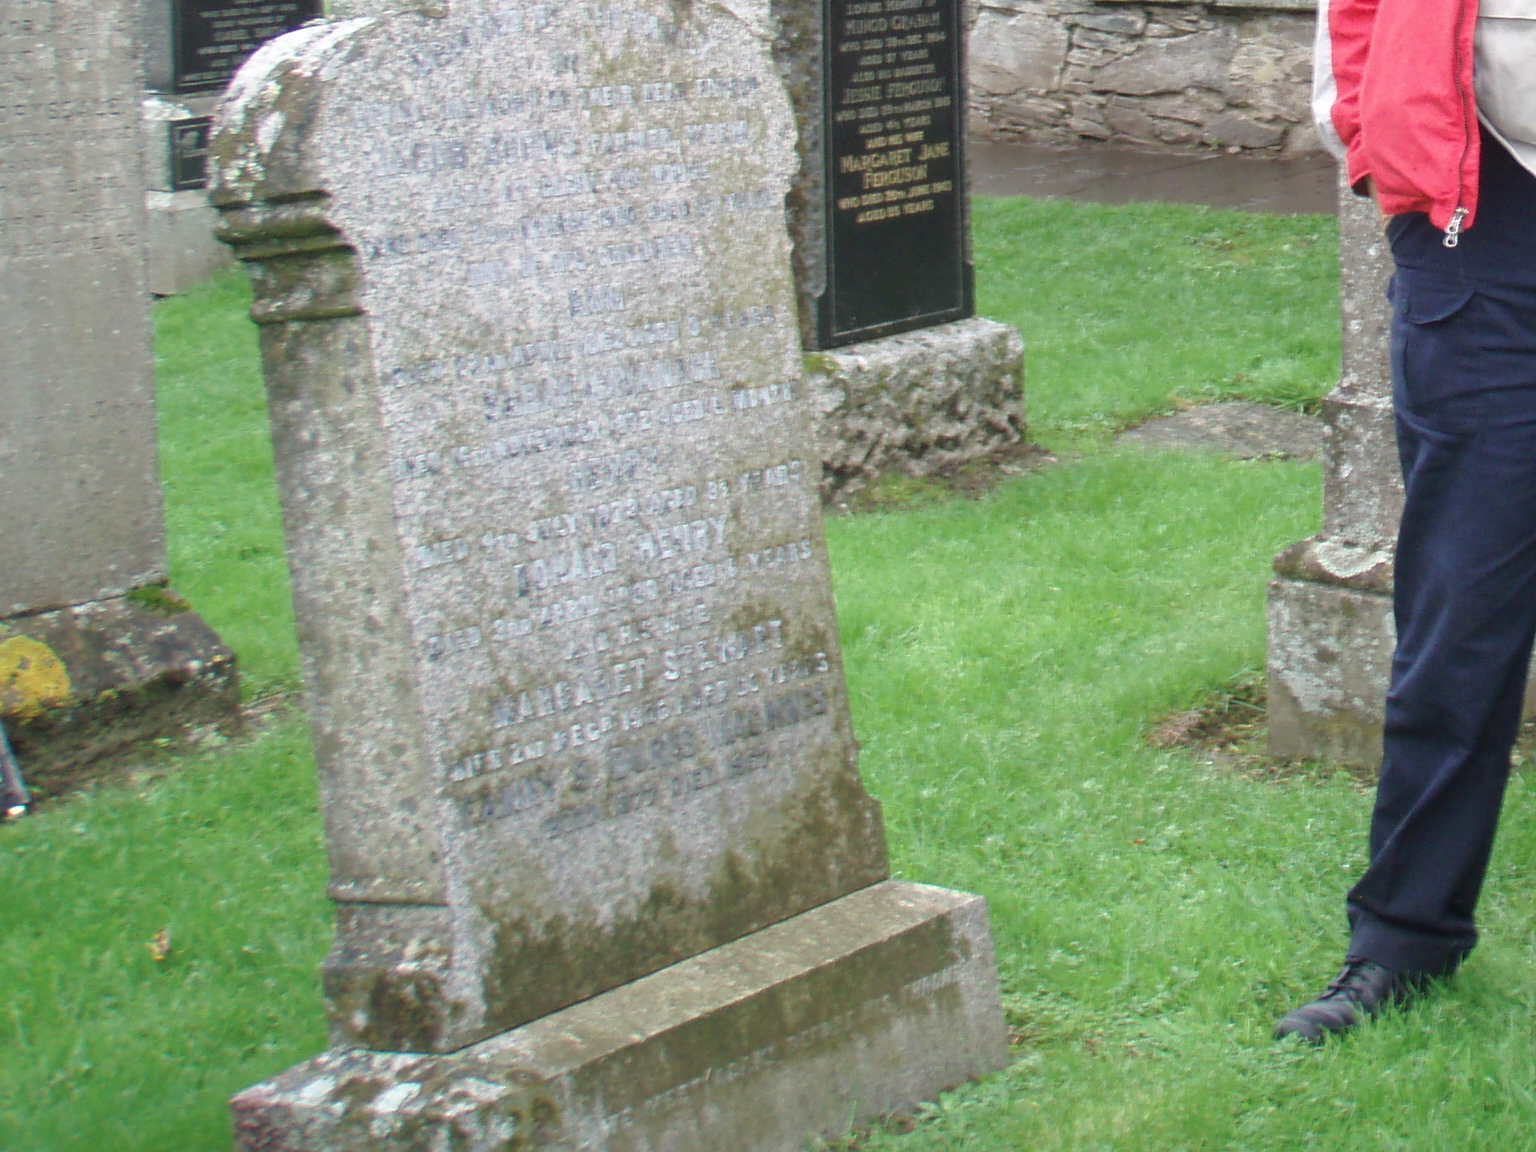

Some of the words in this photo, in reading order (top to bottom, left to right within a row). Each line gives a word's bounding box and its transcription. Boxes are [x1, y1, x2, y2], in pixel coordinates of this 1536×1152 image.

[890, 12, 940, 29] GRAHAM
[839, 148, 912, 173] MARGARET
[918, 142, 950, 160] JANE
[863, 164, 928, 189] FERGUSON
[902, 199, 934, 213] YEARS
[524, 511, 578, 542] JULY
[634, 513, 729, 563] HENRY
[746, 537, 811, 571] YEARS
[488, 655, 650, 727] MARGARET
[661, 617, 784, 680] STEWART
